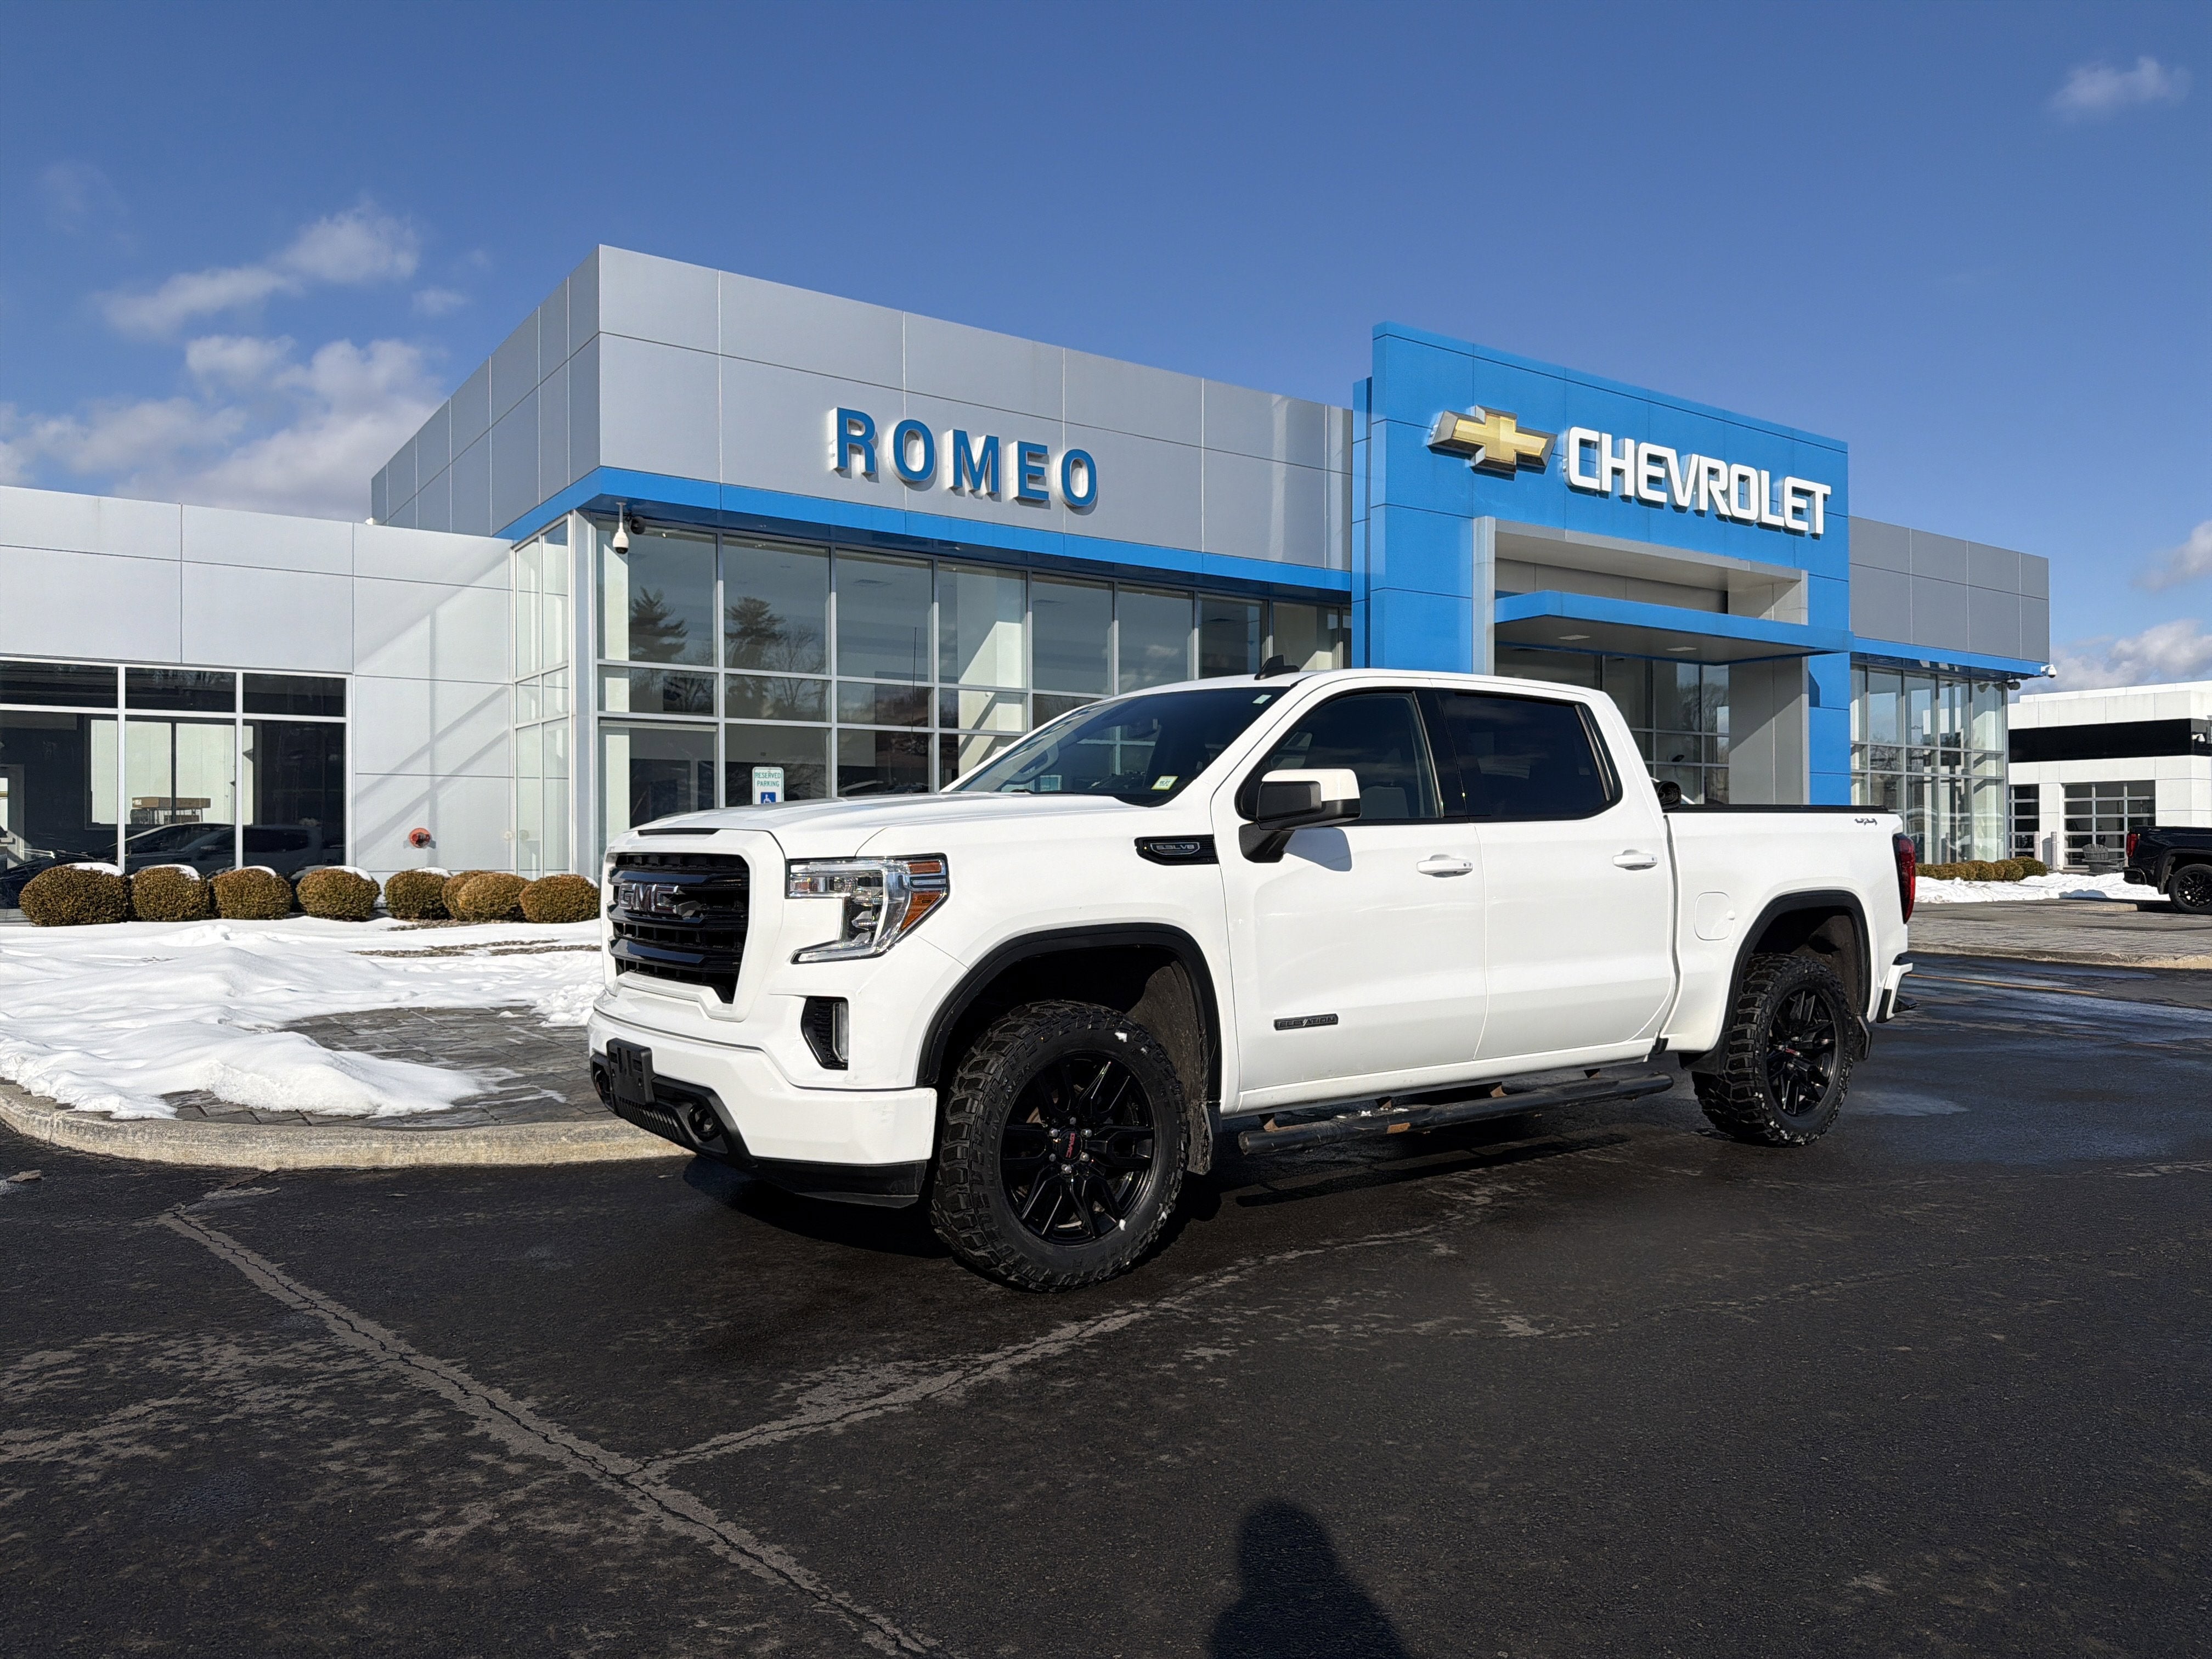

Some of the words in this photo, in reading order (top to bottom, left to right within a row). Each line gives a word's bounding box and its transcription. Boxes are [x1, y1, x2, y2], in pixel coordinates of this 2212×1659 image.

[836, 407, 1097, 506] ROMEO
[1565, 426, 1831, 534] CHEVROLET
[618, 883, 681, 915] GMC
[1278, 1016, 1335, 1028] ELEVATION
